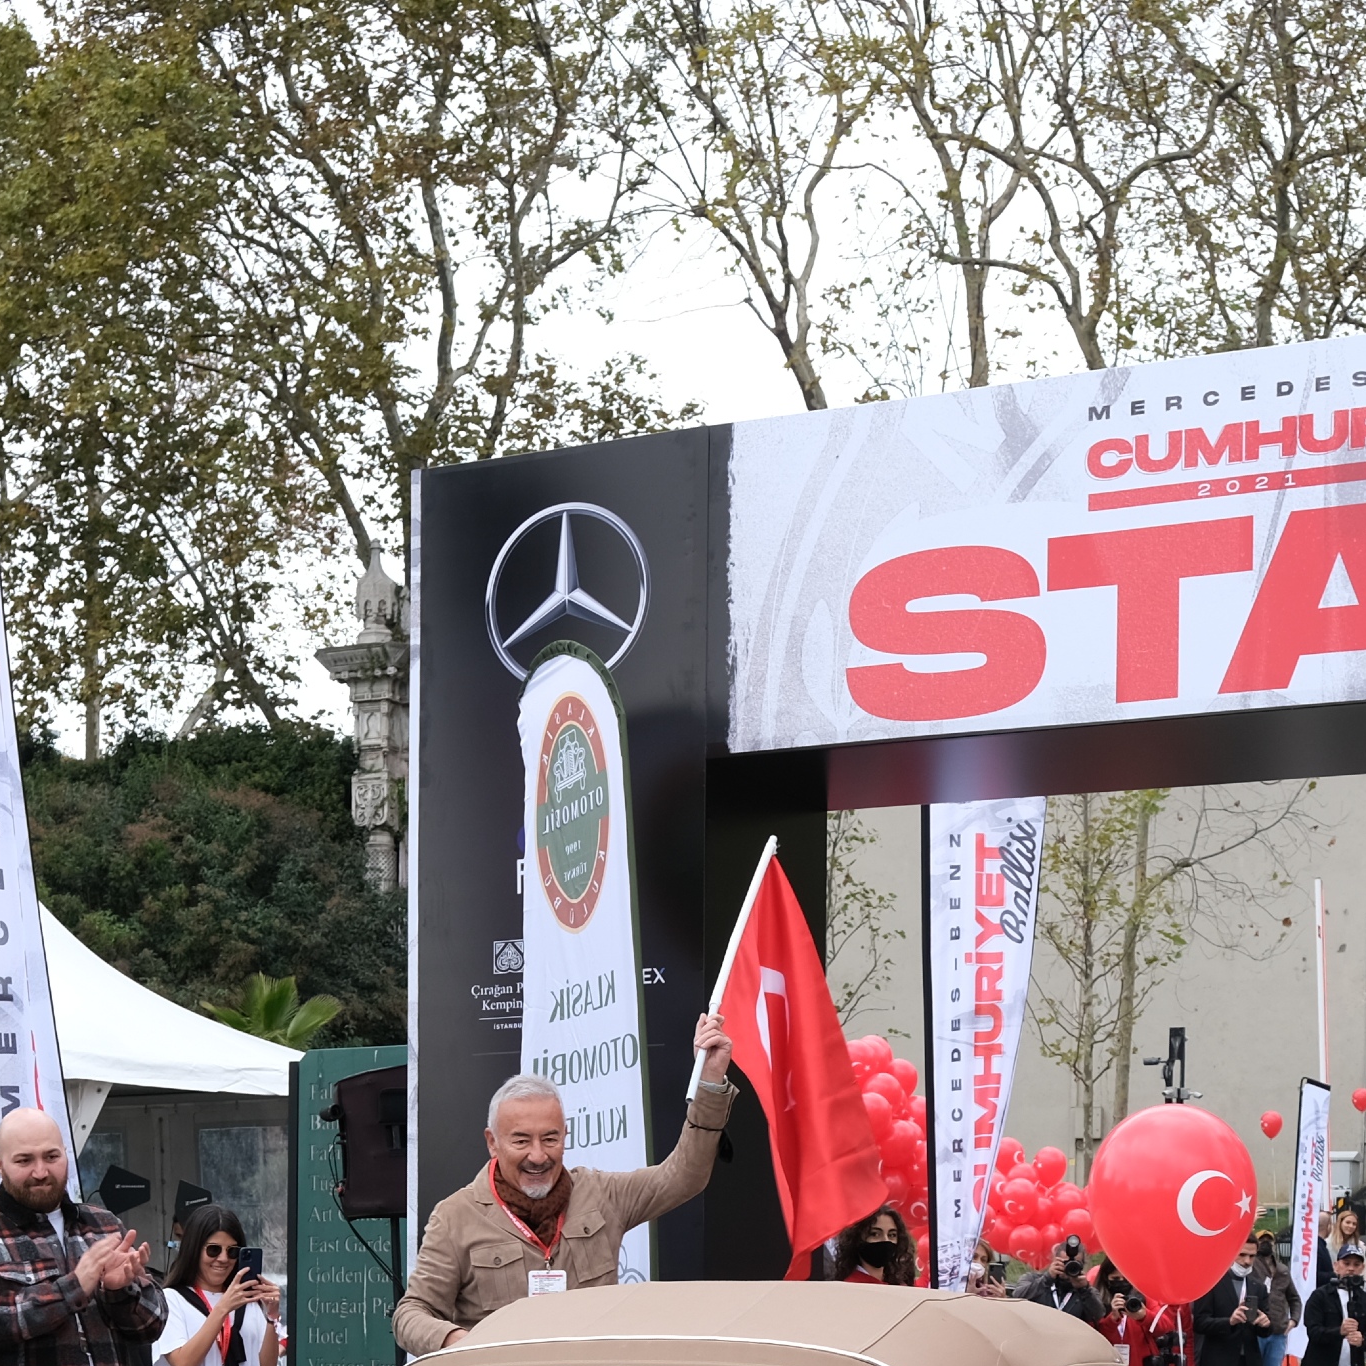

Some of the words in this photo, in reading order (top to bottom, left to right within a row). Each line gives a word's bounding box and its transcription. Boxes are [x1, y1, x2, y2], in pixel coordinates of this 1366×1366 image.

[1197, 473, 1297, 498] 2021
[949, 833, 963, 1219] MERCEDES-BENZ
[309, 1236, 340, 1253] East
[345, 1236, 392, 1253] Garde
[308, 1265, 363, 1284] Golden
[308, 1327, 348, 1344] Hotel
